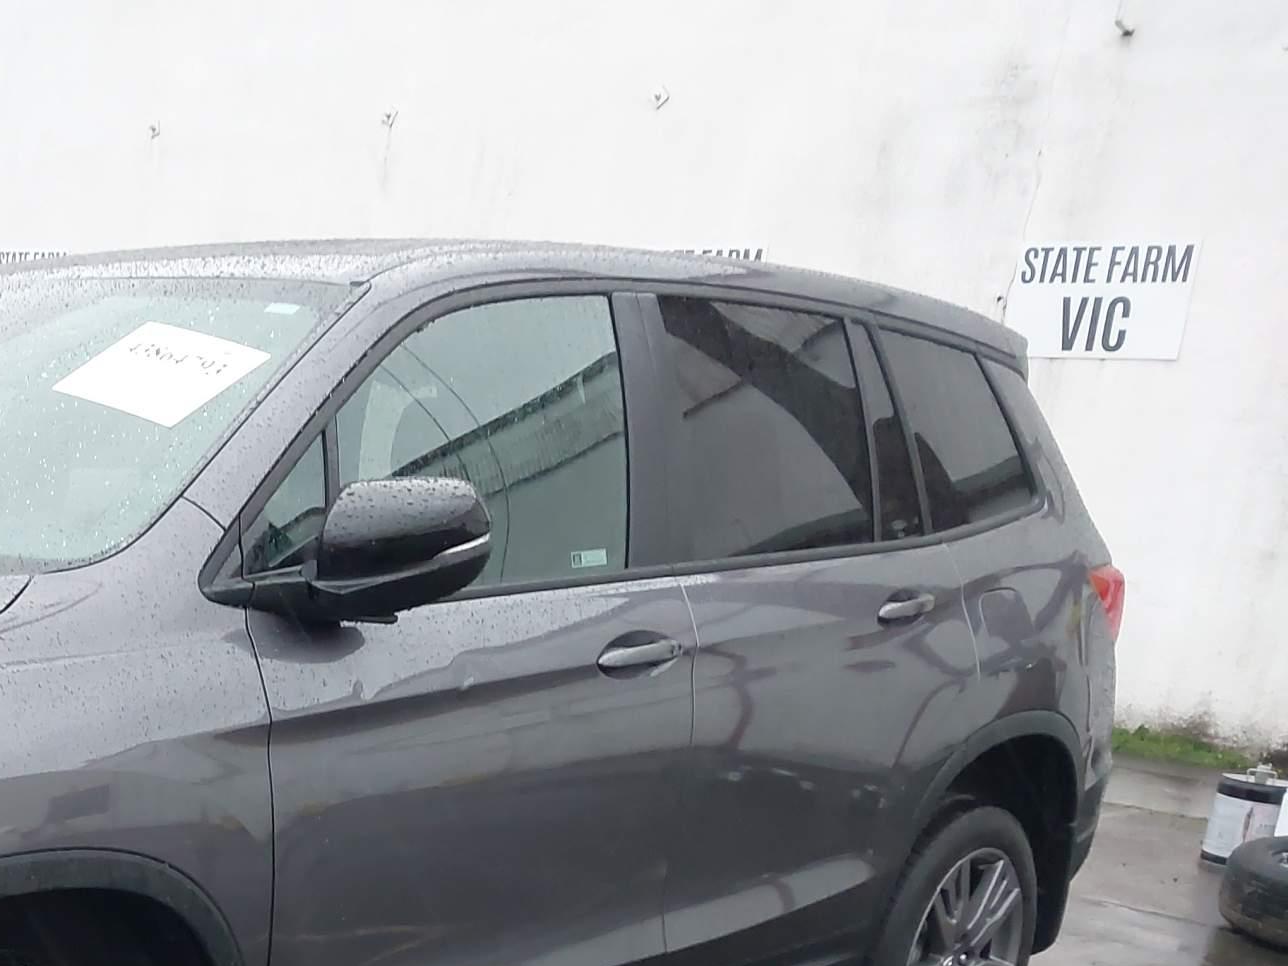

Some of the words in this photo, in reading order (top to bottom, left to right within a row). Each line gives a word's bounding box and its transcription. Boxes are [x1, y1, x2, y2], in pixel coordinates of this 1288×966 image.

[1021, 247, 1101, 283] STATE
[1106, 245, 1194, 283] FARM
[1062, 297, 1130, 352] VIC
